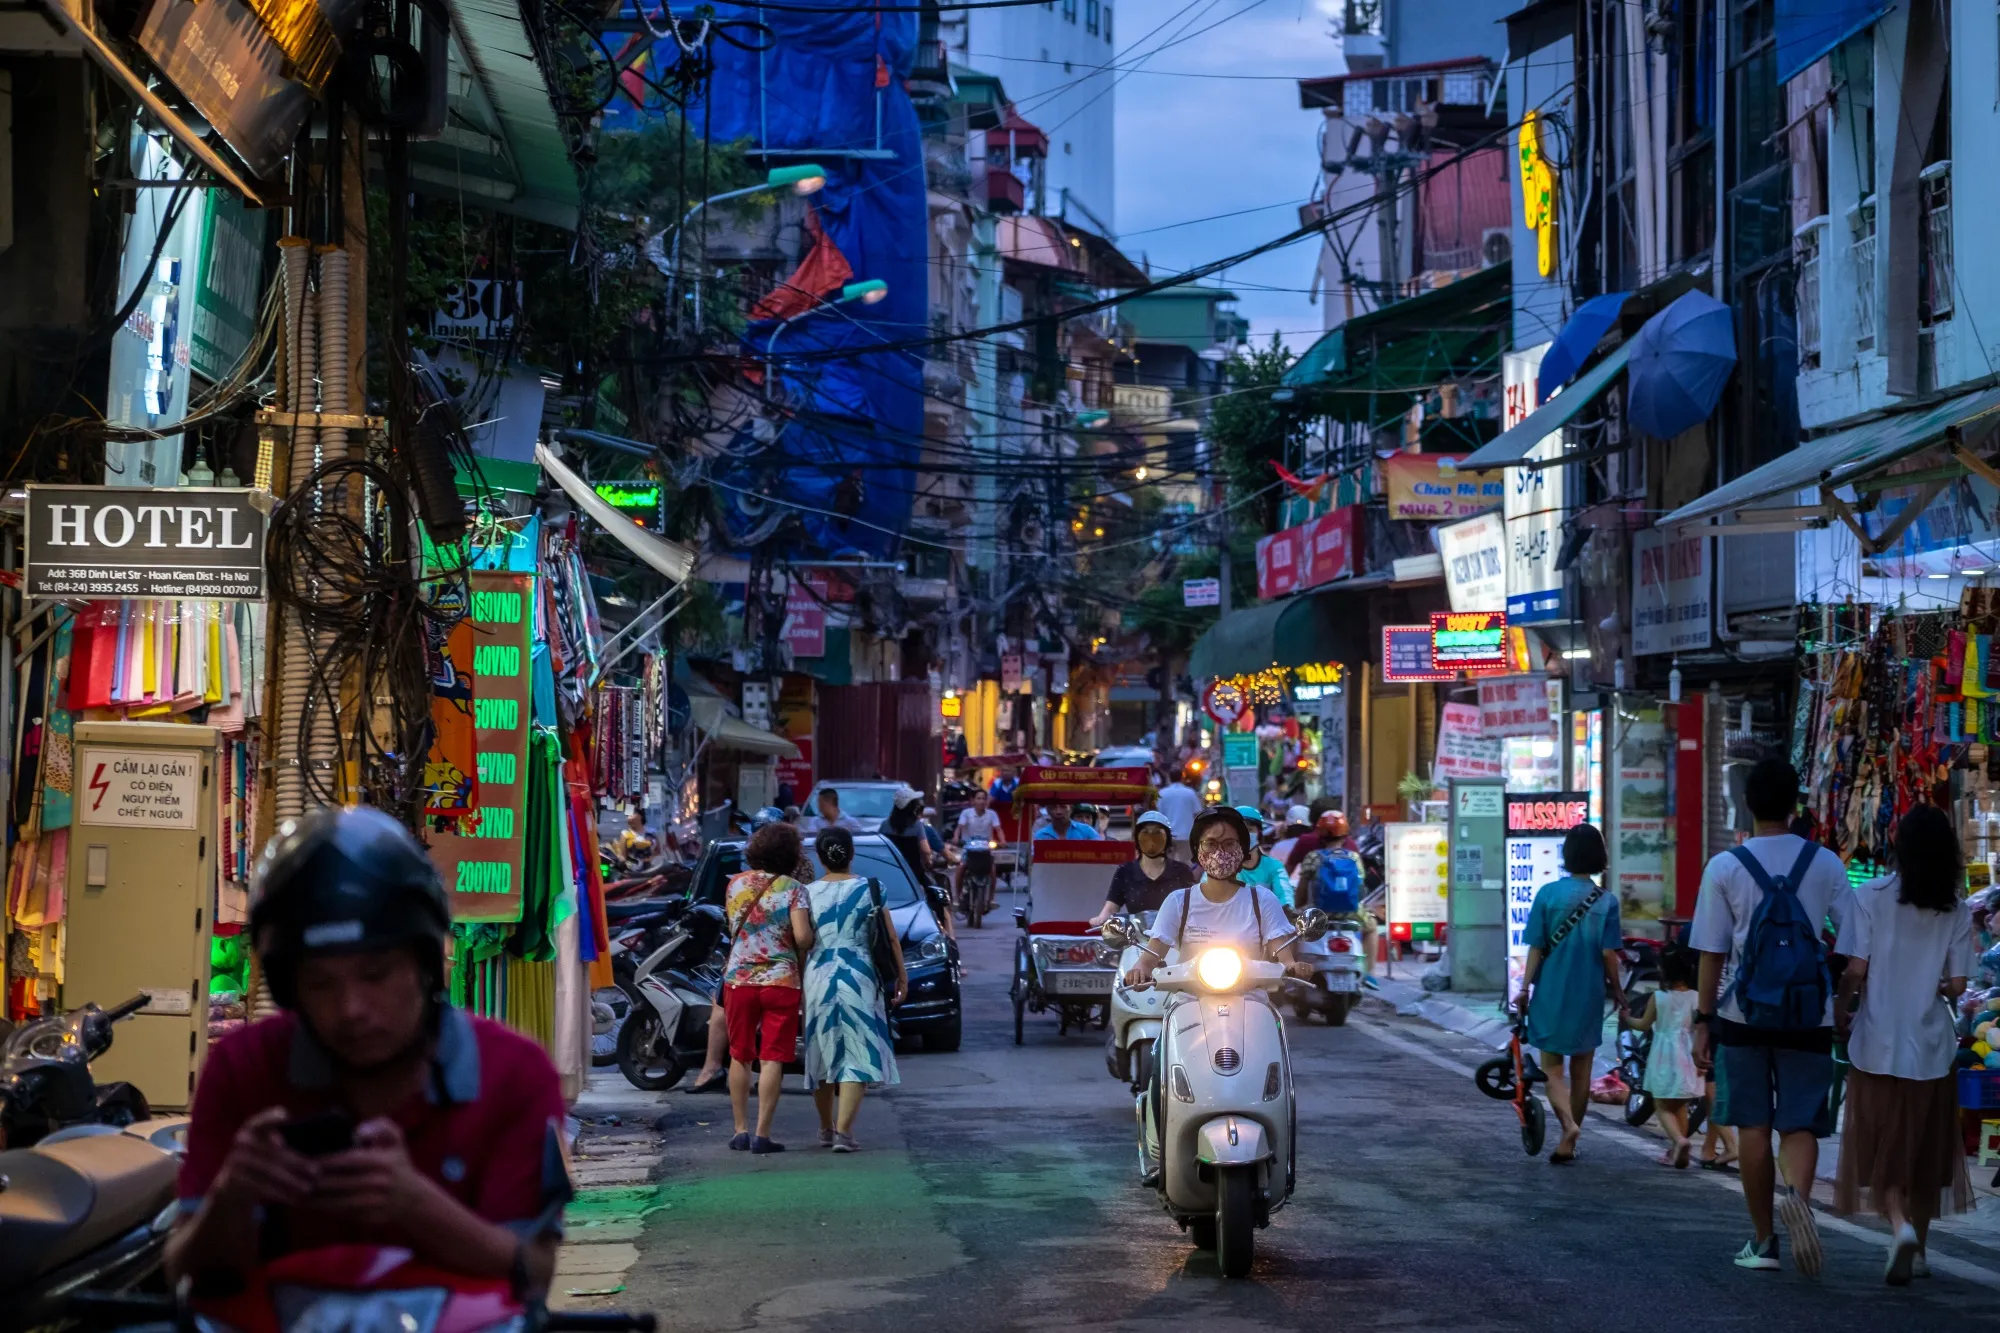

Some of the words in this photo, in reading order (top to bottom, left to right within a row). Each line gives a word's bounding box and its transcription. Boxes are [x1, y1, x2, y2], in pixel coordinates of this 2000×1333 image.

[437, 280, 517, 320] 30
[1517, 456, 1544, 494] SPA
[1443, 500, 1452, 515] 2
[47, 504, 253, 549] HOTEL
[47, 569, 67, 579] Add:
[88, 570, 108, 580] Dinh
[110, 571, 126, 580] Liet
[127, 571, 142, 580] Str
[149, 571, 171, 581] Hoan
[172, 572, 195, 581] Kiem
[196, 572, 213, 581] Dist
[221, 573, 232, 582] Ha
[234, 573, 250, 582] Noi
[38, 582, 52, 591] Tel:
[54, 582, 88, 593] (84-24)
[89, 583, 112, 593] 3935
[115, 583, 139, 593] 2455
[151, 584, 184, 594] Hotline:
[223, 585, 258, 595] 007007
[141, 762, 159, 777] LẠI
[122, 794, 152, 804] NGUY
[1508, 802, 1587, 830] MASSAGE
[1511, 844, 1532, 860] FOOT
[455, 861, 511, 894] 200VND
[1511, 865, 1533, 881] BODY
[1511, 886, 1532, 902] FACE
